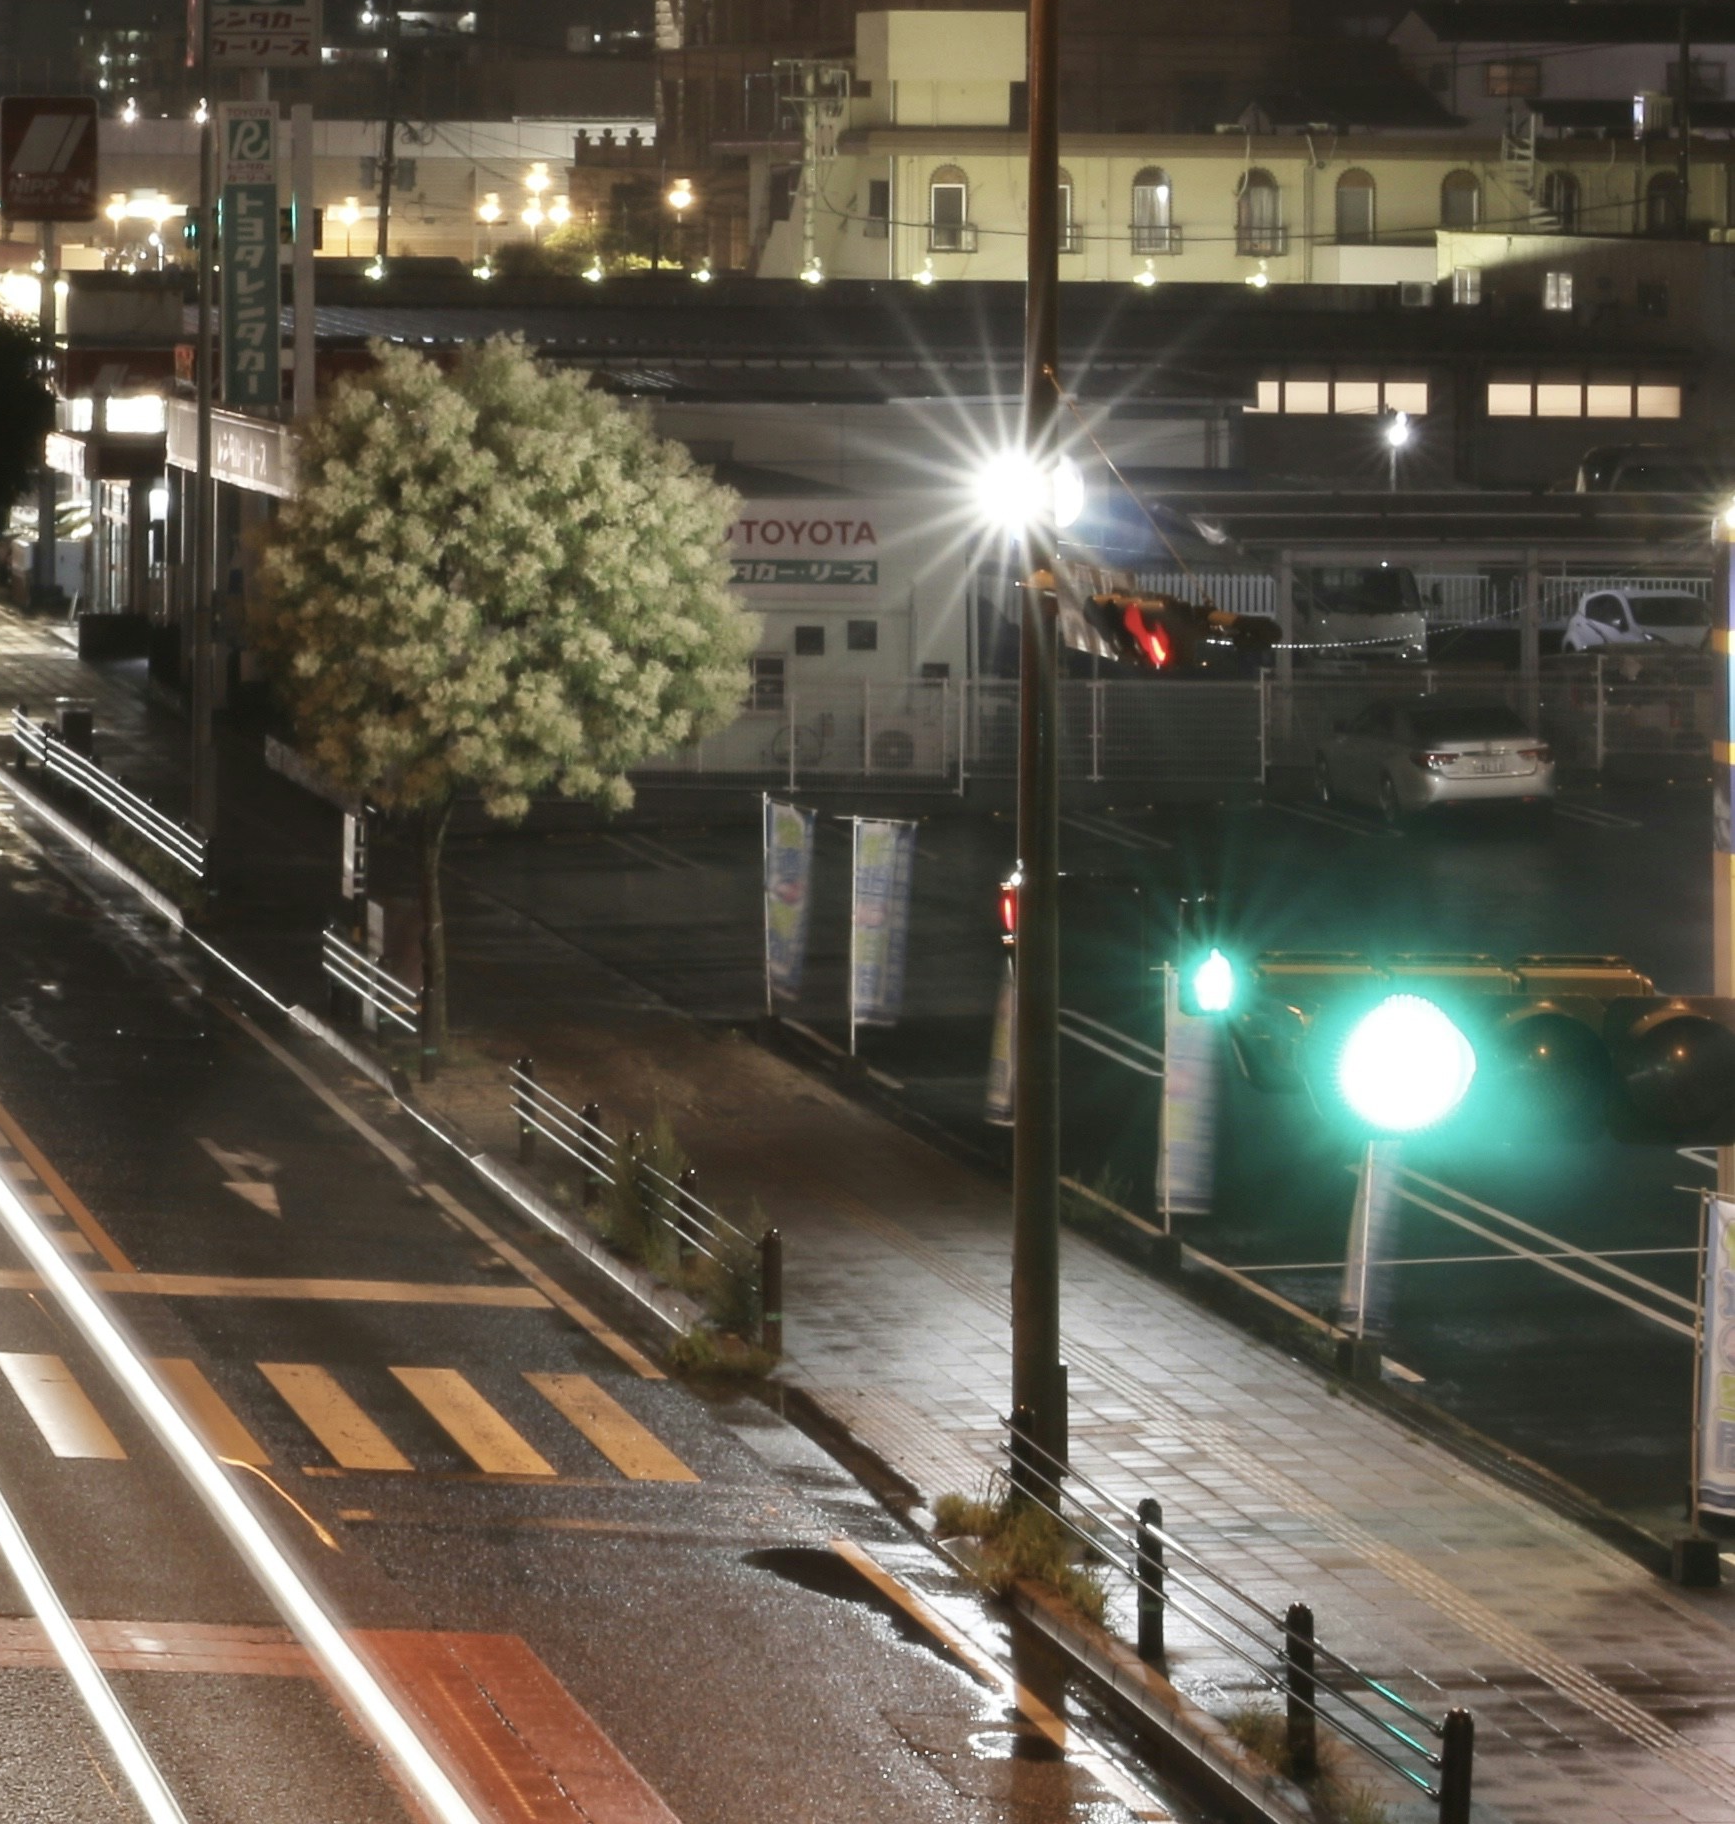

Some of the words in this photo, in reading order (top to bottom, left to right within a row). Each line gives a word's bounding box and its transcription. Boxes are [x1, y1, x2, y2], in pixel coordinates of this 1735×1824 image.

[8, 178, 90, 194] NIPPN
[234, 191, 267, 395] トヨタレンタカー
[740, 519, 877, 546] TOYOTA
